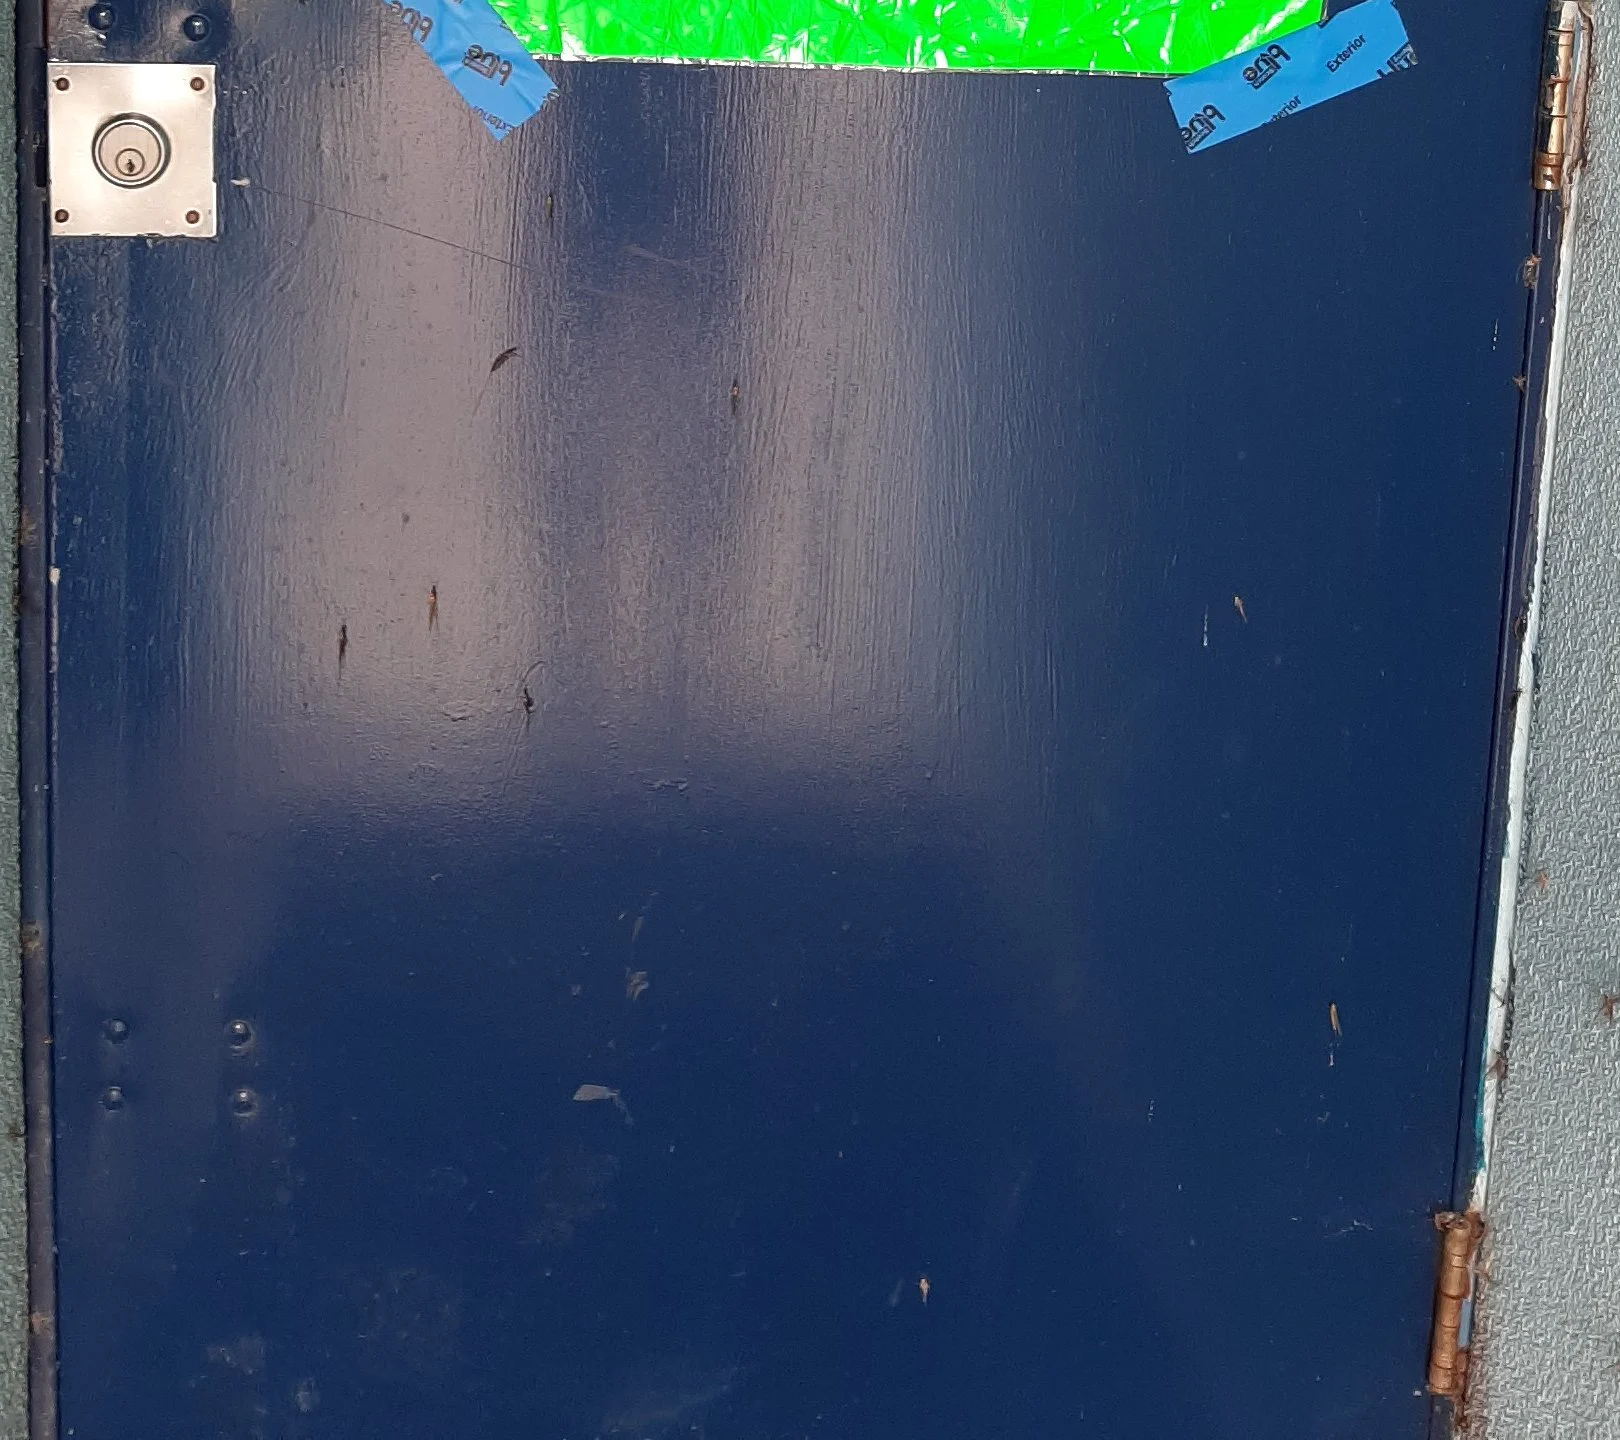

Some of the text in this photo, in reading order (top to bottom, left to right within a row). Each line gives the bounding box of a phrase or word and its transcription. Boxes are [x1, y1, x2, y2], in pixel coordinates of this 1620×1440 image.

[465, 44, 512, 86] blue
[1243, 44, 1291, 82] blue
[1326, 34, 1366, 73] Exterior
